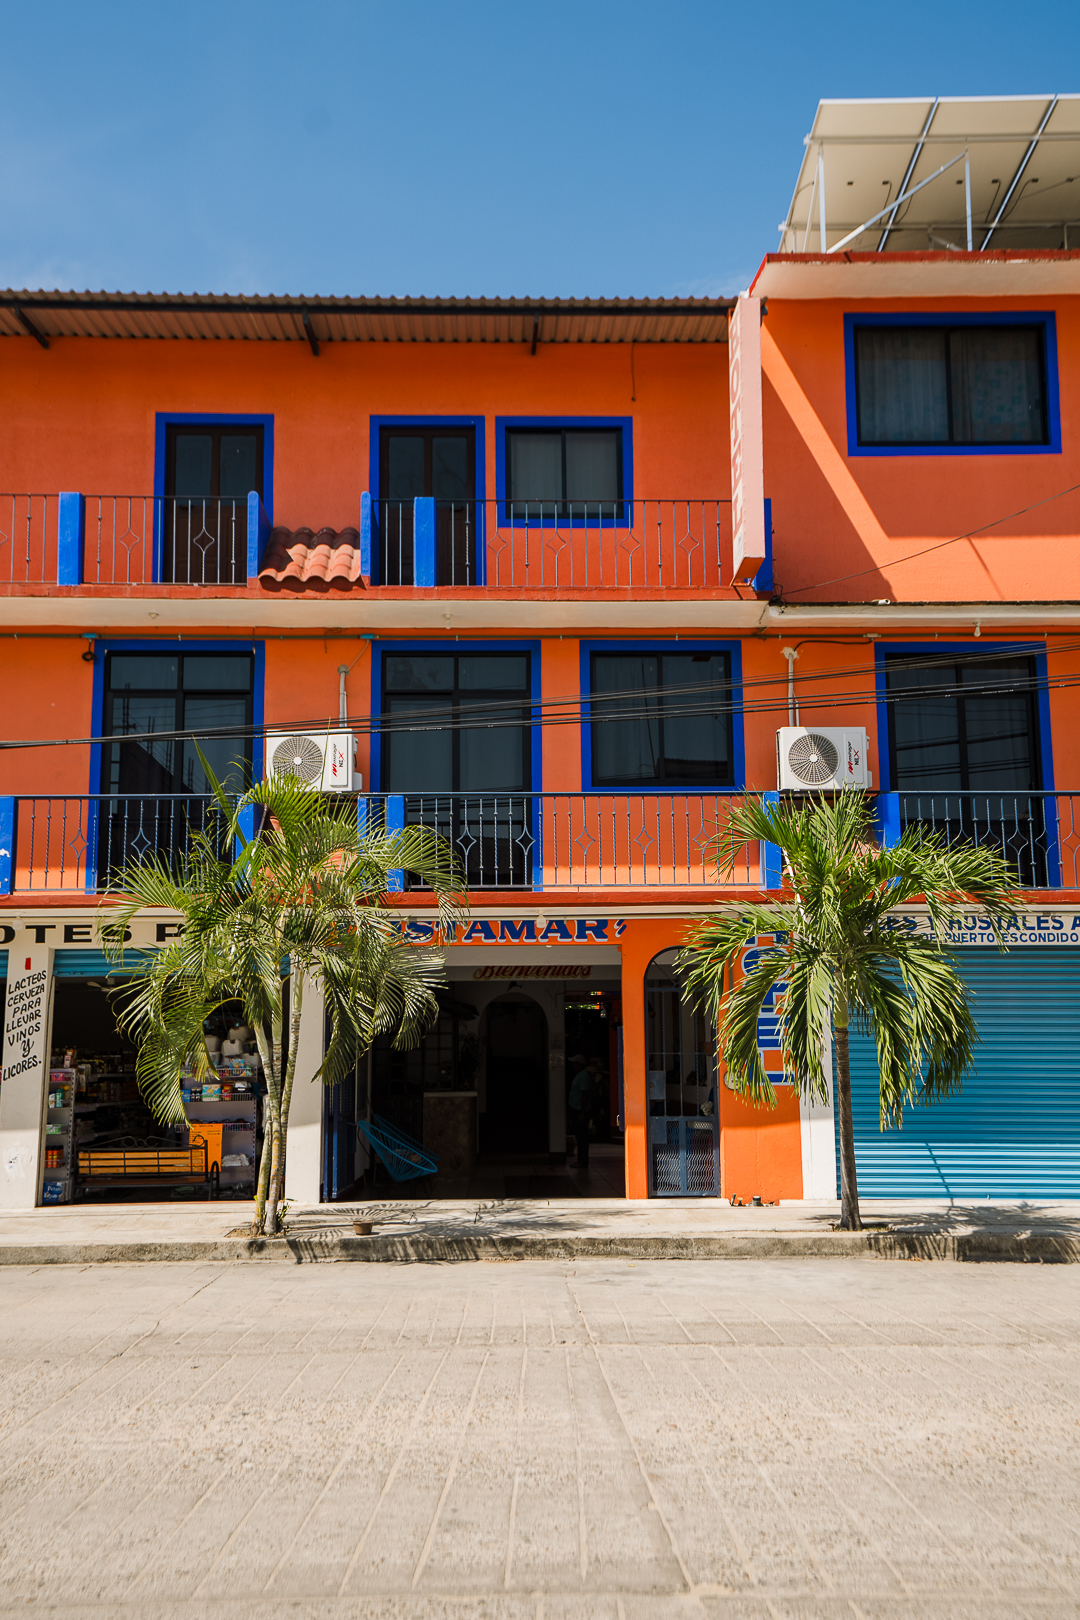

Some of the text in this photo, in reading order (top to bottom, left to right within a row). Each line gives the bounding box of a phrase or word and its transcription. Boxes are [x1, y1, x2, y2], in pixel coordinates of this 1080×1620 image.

[729, 305, 743, 541] HOTEL
[945, 932, 995, 942] PUERTO
[1002, 932, 1079, 942] ESCONDIDO
[8, 970, 47, 995] LACTEOS
[7, 983, 45, 1007] CERVEZA
[12, 997, 41, 1018] PARA
[6, 1009, 41, 1033] LLEVAR
[8, 1022, 41, 1047] VINOS
[3, 1055, 42, 1081] LICORES.
